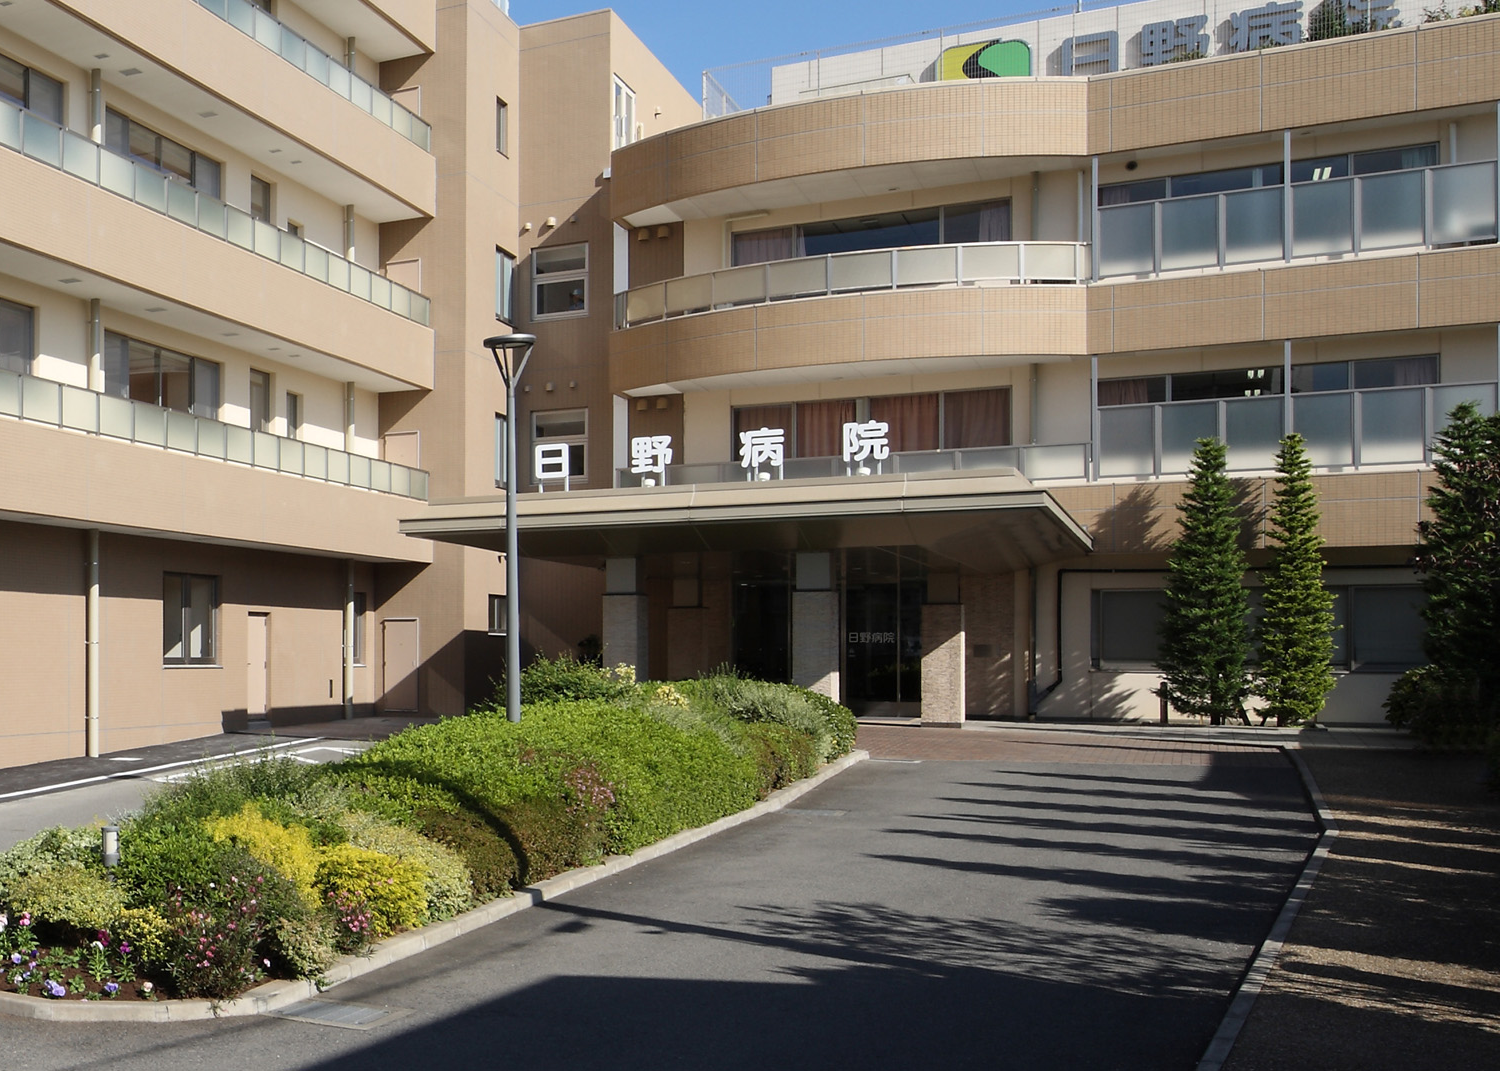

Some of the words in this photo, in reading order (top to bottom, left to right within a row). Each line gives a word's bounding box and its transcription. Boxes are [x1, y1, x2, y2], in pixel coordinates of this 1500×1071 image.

[535, 420, 889, 479] 日野病院
[848, 632, 896, 644] 日野病院
